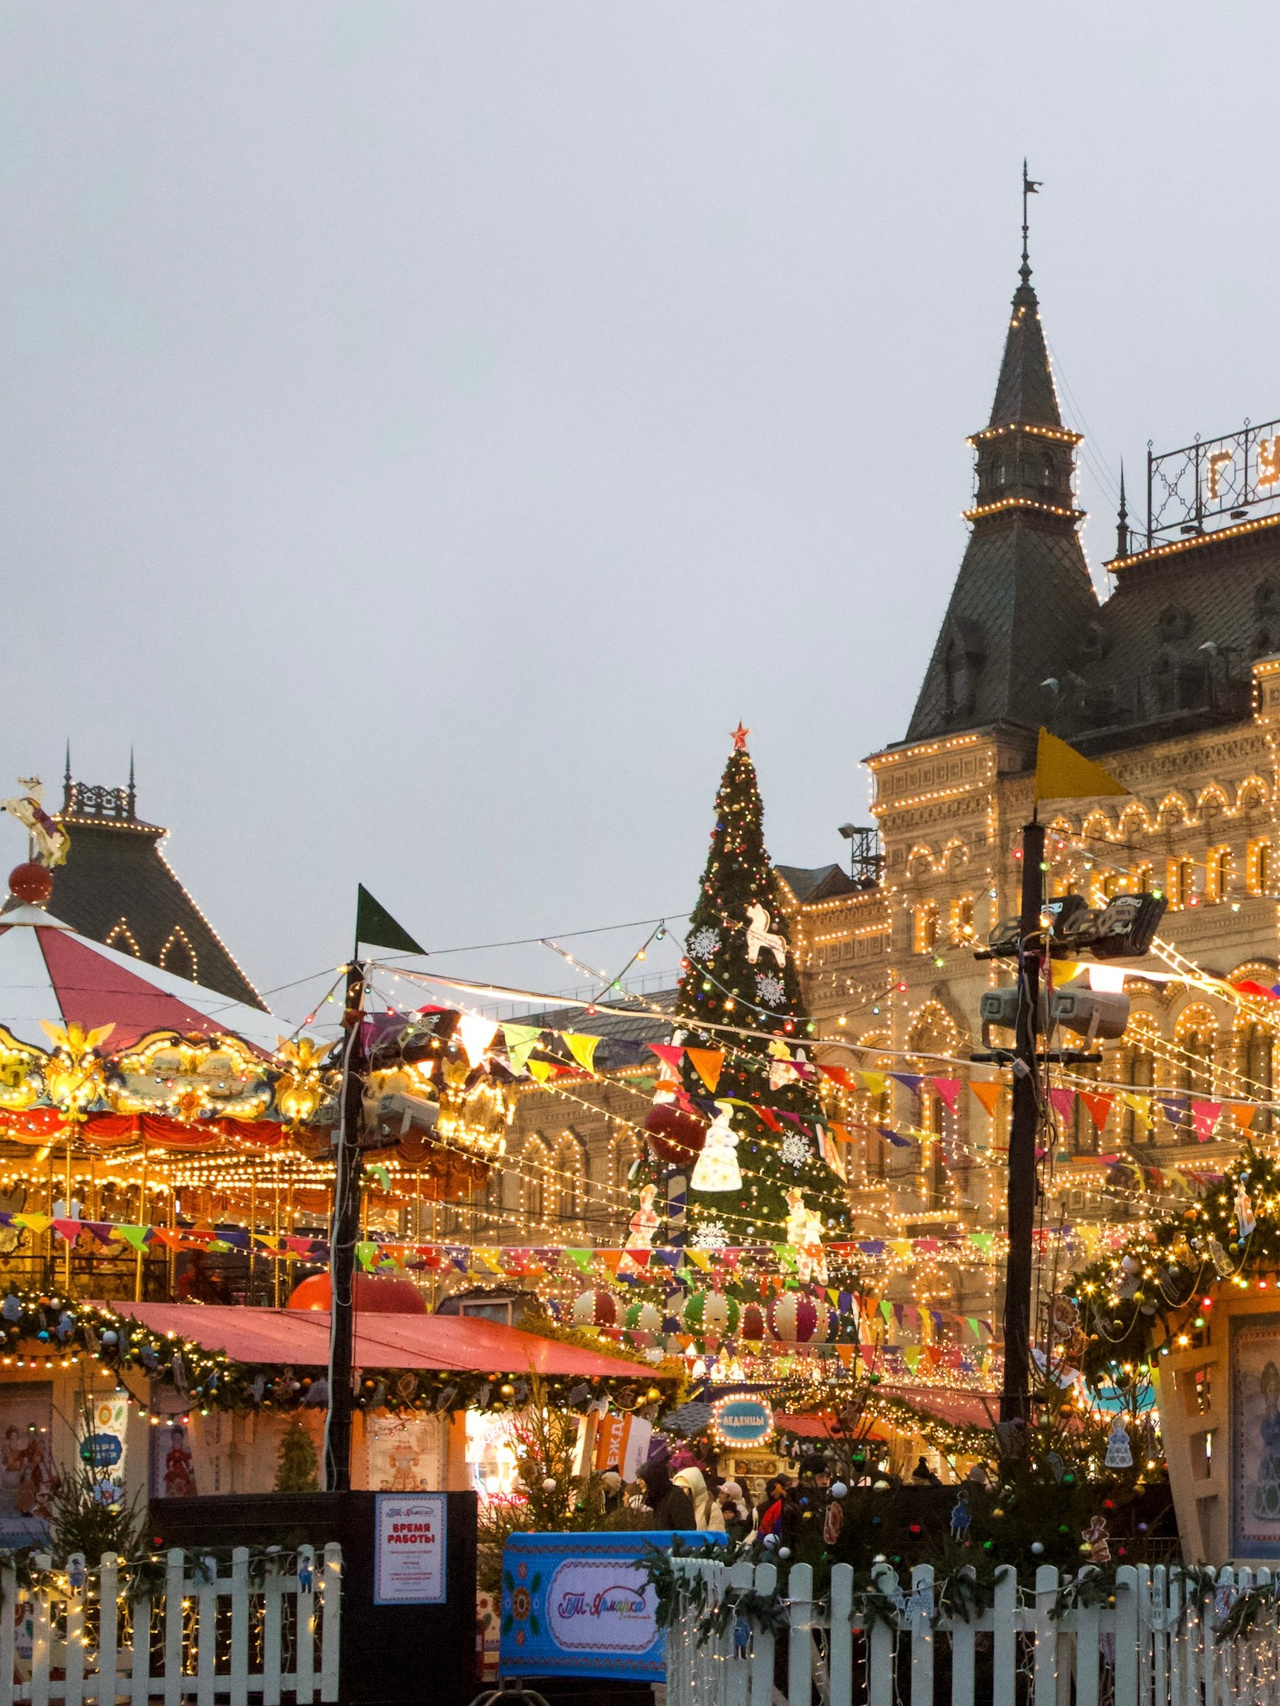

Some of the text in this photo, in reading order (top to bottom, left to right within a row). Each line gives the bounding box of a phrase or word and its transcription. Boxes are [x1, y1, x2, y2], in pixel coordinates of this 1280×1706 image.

[723, 1416, 765, 1427] ЛЕДЕНЦЫ
[392, 1523, 431, 1533] ВРЕМЯ
[387, 1534, 436, 1544] РАБОТЫ
